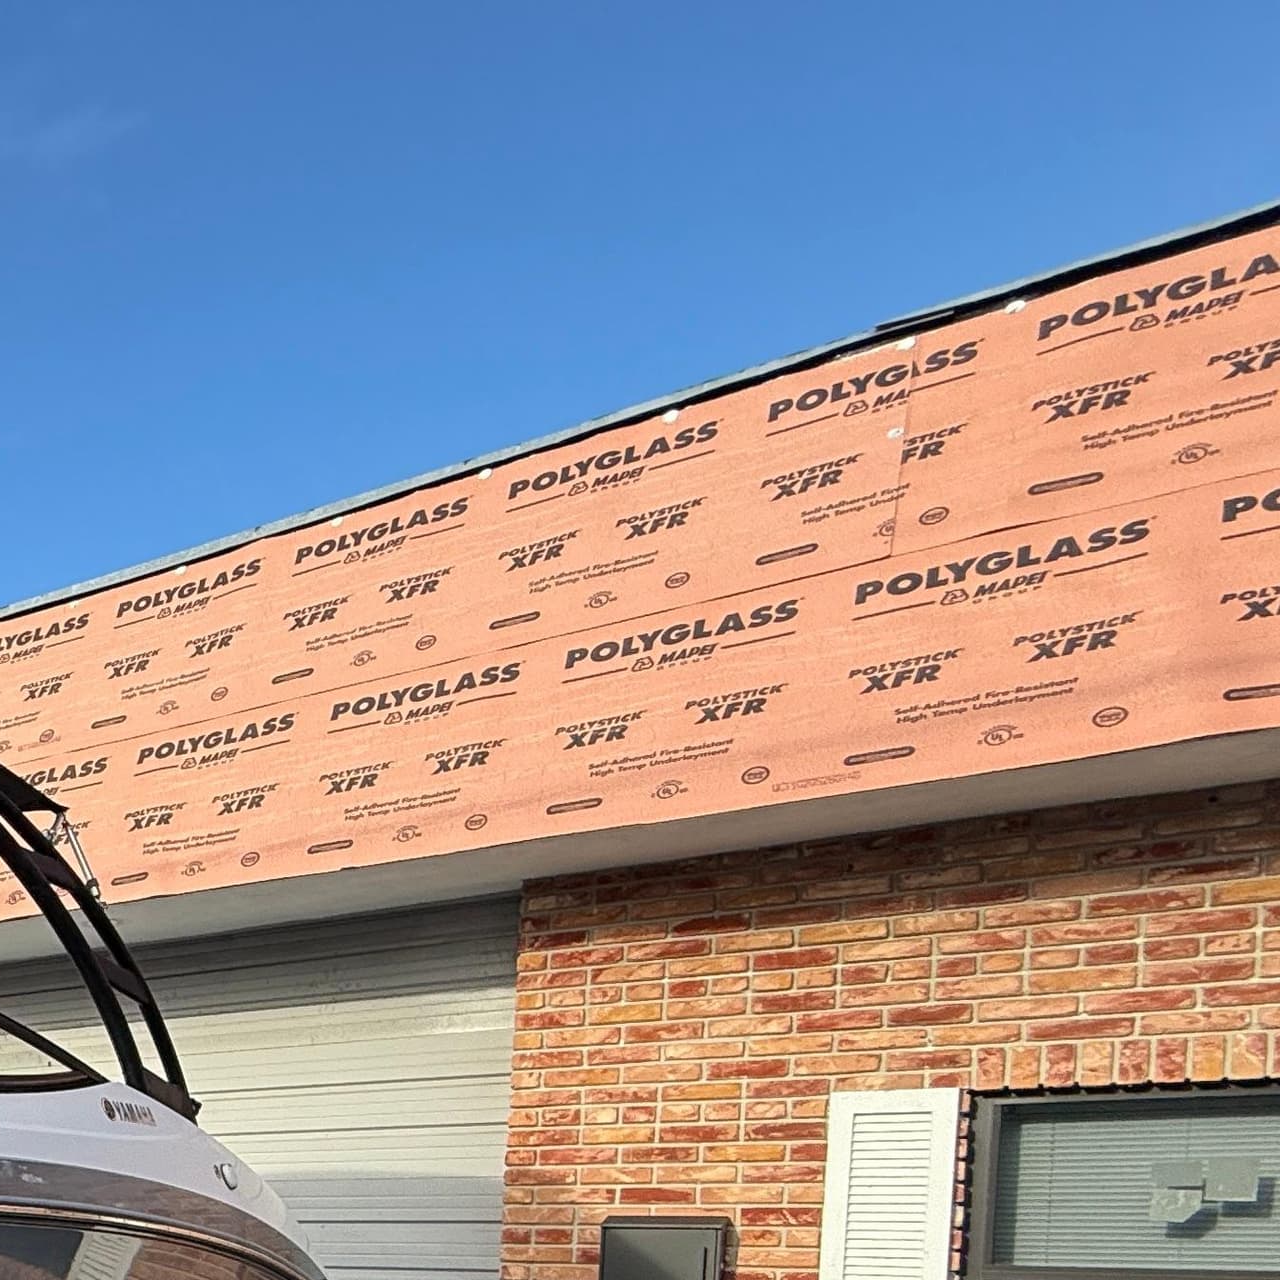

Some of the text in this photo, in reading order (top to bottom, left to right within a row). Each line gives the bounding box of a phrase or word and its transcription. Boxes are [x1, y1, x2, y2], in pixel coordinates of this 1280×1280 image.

[1164, 291, 1246, 324] MAPEI
[1031, 371, 1155, 412] POLYSTICK
[1043, 389, 1132, 424] XFR
[1080, 389, 1279, 442] Self-Adhered Fire-Resistant
[1081, 400, 1273, 451] High Temp Underlayment
[508, 419, 722, 500] POLYGLASS
[760, 453, 863, 489] POLYSTICK
[591, 465, 648, 491] MAPEI
[769, 469, 844, 502] XFR
[615, 496, 707, 528] POLYSTICK
[801, 492, 877, 518] Self-Adhered
[801, 505, 866, 525] High Temp
[294, 495, 472, 565] POLYGLASS
[622, 511, 689, 540] XFR
[363, 536, 411, 559] MAPEI
[498, 528, 583, 560] POLYSTICK
[502, 543, 565, 573] XFR
[528, 550, 659, 587] Self-Adhered Fire-Resistant
[855, 515, 1155, 606] POLYGLASS
[116, 557, 265, 618] POLYGLASS
[379, 566, 455, 592] POLYSTICK
[382, 576, 440, 604] XFR
[528, 558, 655, 594] High Temp Underlayment
[972, 570, 1052, 598] MAPEI
[283, 594, 352, 620] POLYSTICK
[285, 603, 341, 632] XFR
[184, 623, 248, 648] POLYSTICK
[306, 639, 329, 652] High
[350, 622, 410, 641] Underlayment
[564, 597, 803, 670] POLYGLASS
[1012, 611, 1141, 647] POLYSTICK
[104, 648, 163, 670] POLYSTICK
[187, 631, 235, 658] XFR
[656, 642, 720, 665] MAPEI
[1025, 629, 1118, 663] XFR
[105, 655, 150, 680] XFR
[848, 648, 965, 679] POLYSTICK
[859, 660, 942, 695] XFR
[20, 671, 75, 692] POLYSTICK
[22, 682, 62, 702] XFR
[330, 660, 525, 721] POLYGLASS
[894, 677, 1079, 715] Self-Adhered Fire-Resistant
[405, 700, 456, 720] MAPEI
[684, 683, 789, 710] POLYSTICK
[692, 694, 767, 725] XFR
[894, 687, 1074, 724] High Temp Underlayment
[554, 709, 648, 736] POLYSTICK
[136, 712, 298, 765] POLYGLASS
[424, 738, 508, 761] POLYSTICK
[563, 724, 629, 751] XFR
[197, 748, 244, 769] MAPEI
[429, 746, 494, 776] XFR
[588, 738, 734, 770] Self-Adhered Fire-Resistant
[588, 747, 729, 777] High Temp Underlayment
[319, 761, 396, 783] POLYSTICK
[322, 769, 382, 796] XFR
[211, 783, 280, 804] POLYSTICK
[215, 791, 266, 816] XFR
[344, 788, 461, 814] Self-Adhered Fire-Resistant
[124, 802, 188, 820] POLYSTICK
[125, 808, 177, 832] XFR
[344, 796, 456, 821] High Temp Underlayment
[115, 1100, 157, 1127] YAMAHA
